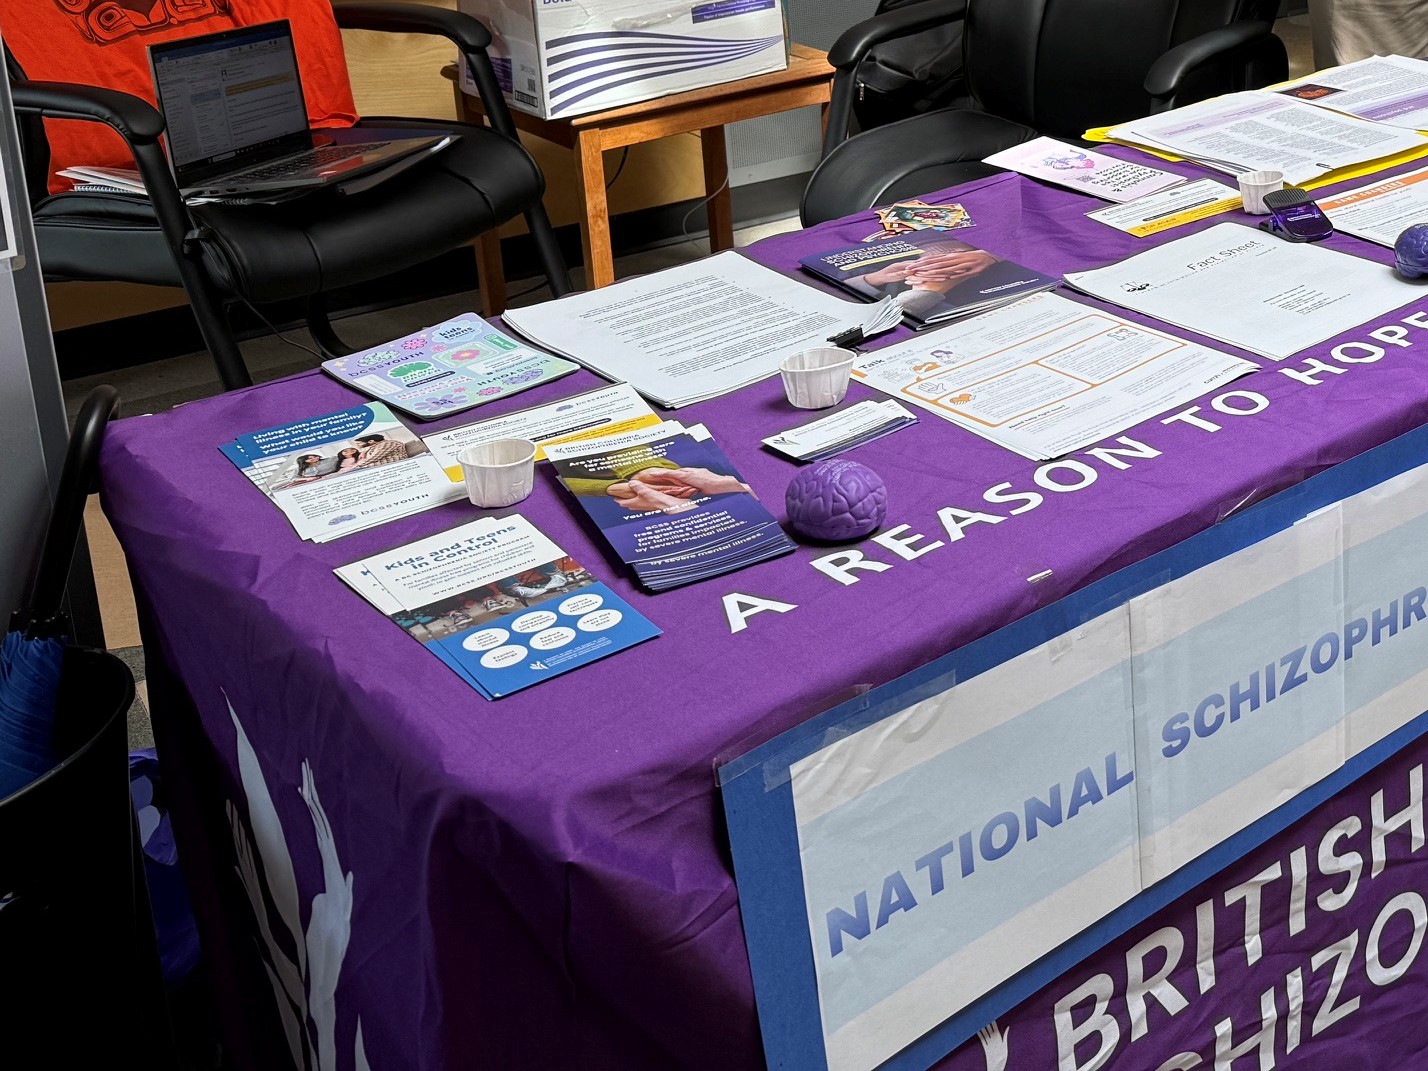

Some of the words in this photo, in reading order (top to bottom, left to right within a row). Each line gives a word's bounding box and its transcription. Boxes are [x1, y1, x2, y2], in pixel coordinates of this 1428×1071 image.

[1334, 193, 1360, 205] GAME
[1362, 181, 1404, 199] CHANGERS
[1187, 255, 1216, 271] Fact
[1219, 240, 1261, 257] Sheet
[440, 326, 462, 337] kids
[444, 327, 472, 339] teens
[859, 359, 884, 370] Talk
[253, 428, 285, 440] Living
[286, 421, 310, 431] with
[312, 413, 348, 425] mental
[256, 433, 290, 443] illness
[304, 423, 327, 432] your
[328, 413, 368, 425] family?
[260, 439, 289, 449] What
[291, 431, 324, 442] would
[325, 426, 344, 435] you
[345, 420, 365, 429] like
[263, 446, 288, 455] your
[290, 437, 316, 448] child
[331, 425, 364, 437] know?
[569, 459, 586, 467] Are
[587, 456, 605, 465] you
[607, 446, 652, 461] providing
[652, 441, 675, 451] care
[599, 454, 642, 467] someone
[644, 447, 666, 457] with
[361, 493, 428, 515] bcssYOUTH
[645, 509, 662, 517] are
[663, 505, 676, 513] not
[678, 496, 712, 510] alone.
[722, 593, 798, 634] A
[810, 437, 1168, 587] REASON
[1161, 390, 1271, 433] TO
[384, 555, 425, 571] Kids
[430, 543, 460, 557] and
[464, 526, 516, 545] Teens
[411, 562, 430, 570] in
[434, 537, 498, 562] Control
[826, 751, 1135, 959] NATIONAL
[1053, 763, 1426, 1071] BRITISH
